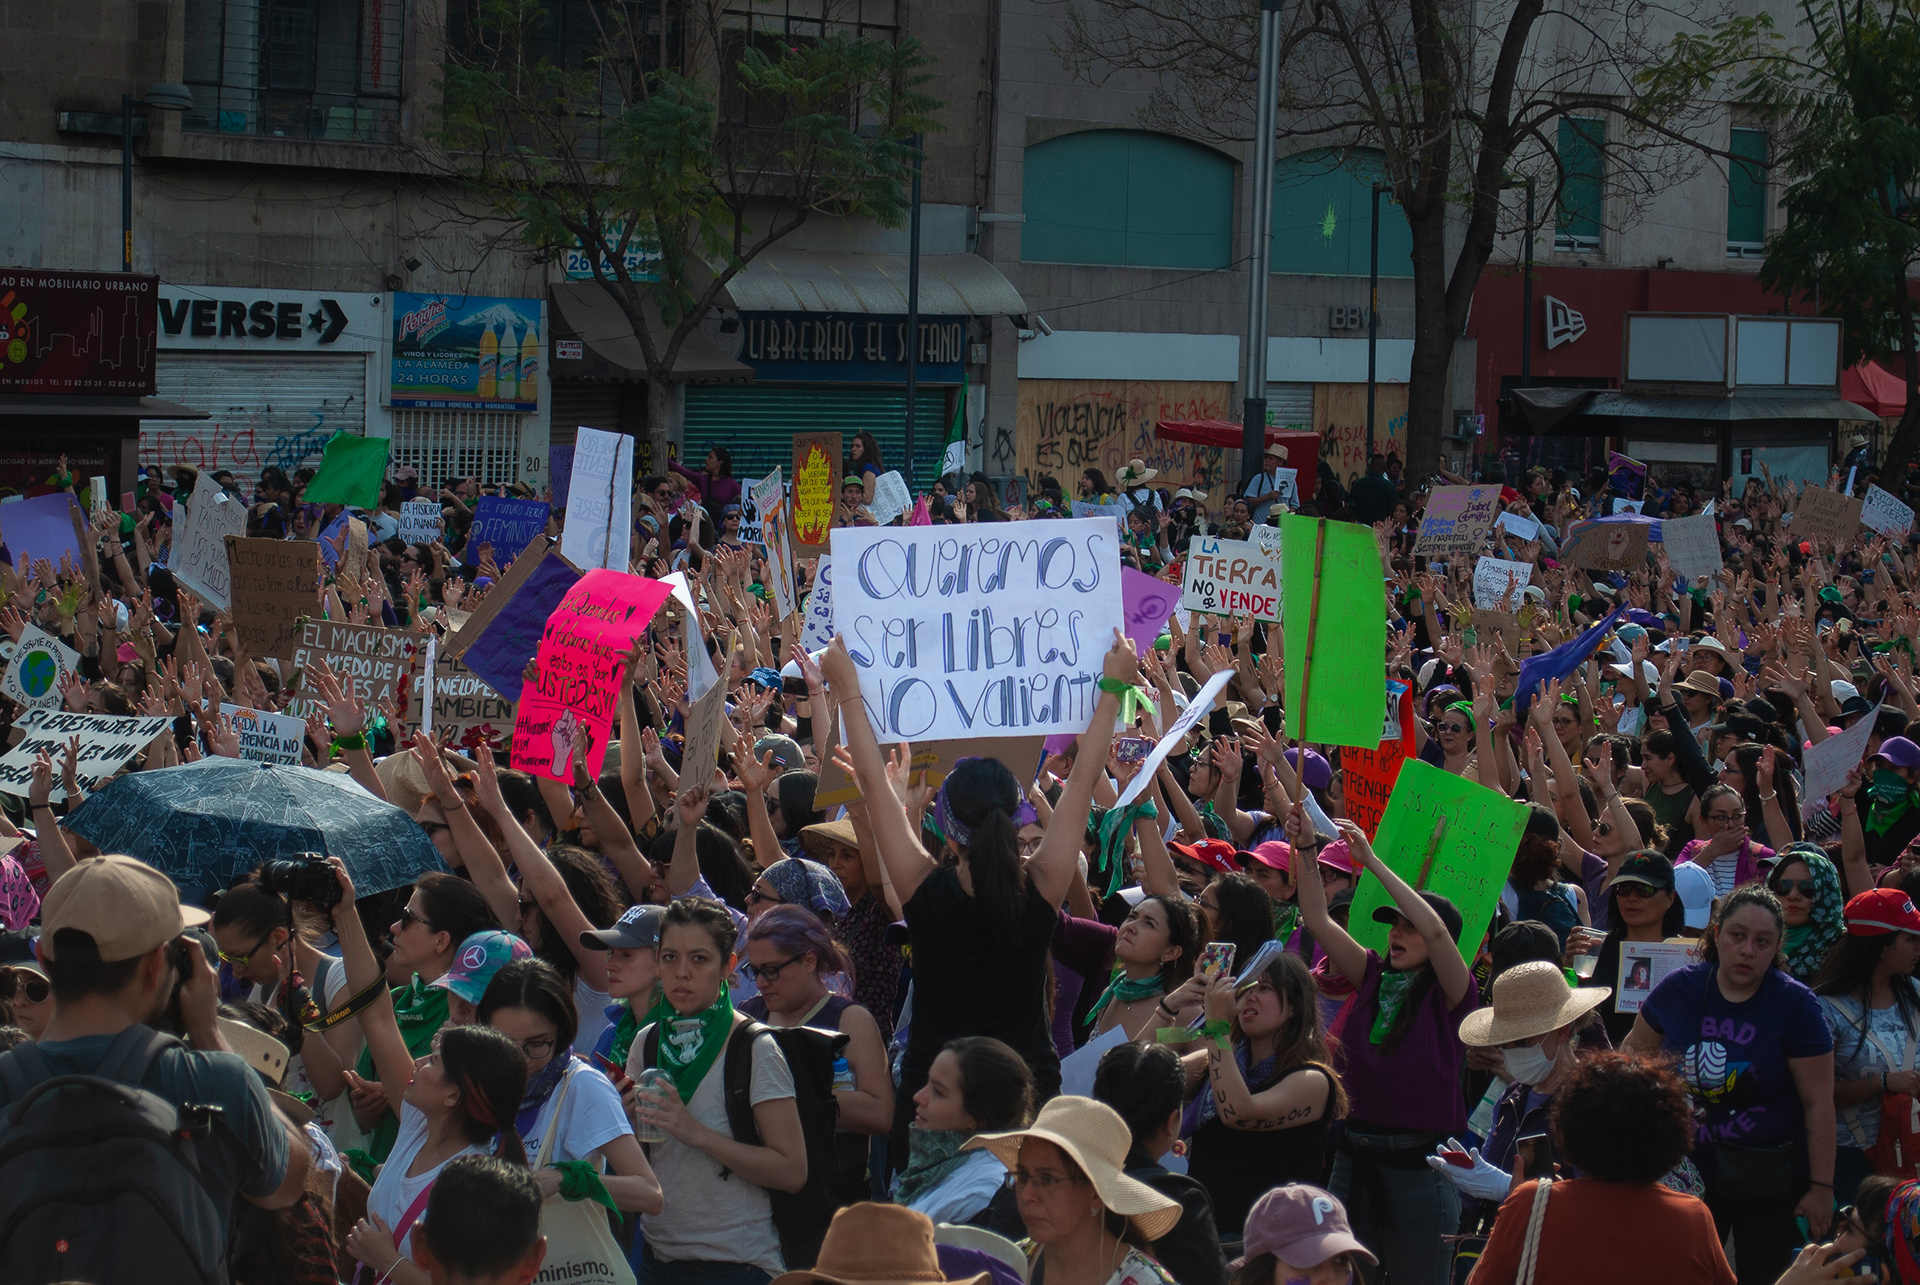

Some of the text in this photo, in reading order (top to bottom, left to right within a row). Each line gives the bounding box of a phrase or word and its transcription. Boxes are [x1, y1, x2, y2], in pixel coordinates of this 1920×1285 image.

[20, 277, 34, 288] EN
[38, 278, 101, 290] MOBILIARIO
[105, 281, 149, 292] URBANO
[750, 314, 961, 363] LIBRERÍAS EL STANO
[398, 360, 470, 370] LA ALAMEDA
[398, 373, 467, 384] 24 HORAS
[1037, 402, 1126, 437] VIOLENCIA
[1037, 437, 1099, 469] ES QUE
[526, 457, 540, 471] 20
[401, 502, 441, 515] LA HISTORIA
[479, 501, 545, 519] EL FUTURO SERÁ
[1466, 501, 1491, 512] Isabel
[1895, 503, 1913, 521] LINDO
[400, 518, 412, 530] NO
[485, 518, 541, 543] FEMINISTA
[1202, 539, 1219, 554] LA
[1433, 533, 1468, 542] nosotras
[276, 544, 292, 569] las
[297, 554, 317, 572] que
[202, 561, 229, 597] MIEDO
[1192, 579, 1214, 596] NO
[1220, 589, 1276, 616] VENDE
[303, 624, 325, 648] EL
[13, 637, 53, 664] DESTRUYE EL
[294, 649, 310, 668] EL
[374, 661, 394, 680] DE
[550, 654, 609, 685] esto es por
[7, 675, 60, 709] NO EL PLANETA
[378, 683, 390, 701] A
[20, 710, 48, 726] SI
[41, 714, 90, 734] ERES
[137, 717, 168, 736] LA
[263, 720, 277, 735] LA
[283, 739, 299, 754] NO
[325, 1007, 351, 1026] Nikon
[1701, 1016, 1756, 1045] BAD
[1211, 1050, 1222, 1081] NI
[1252, 1106, 1311, 1129] MENOS
